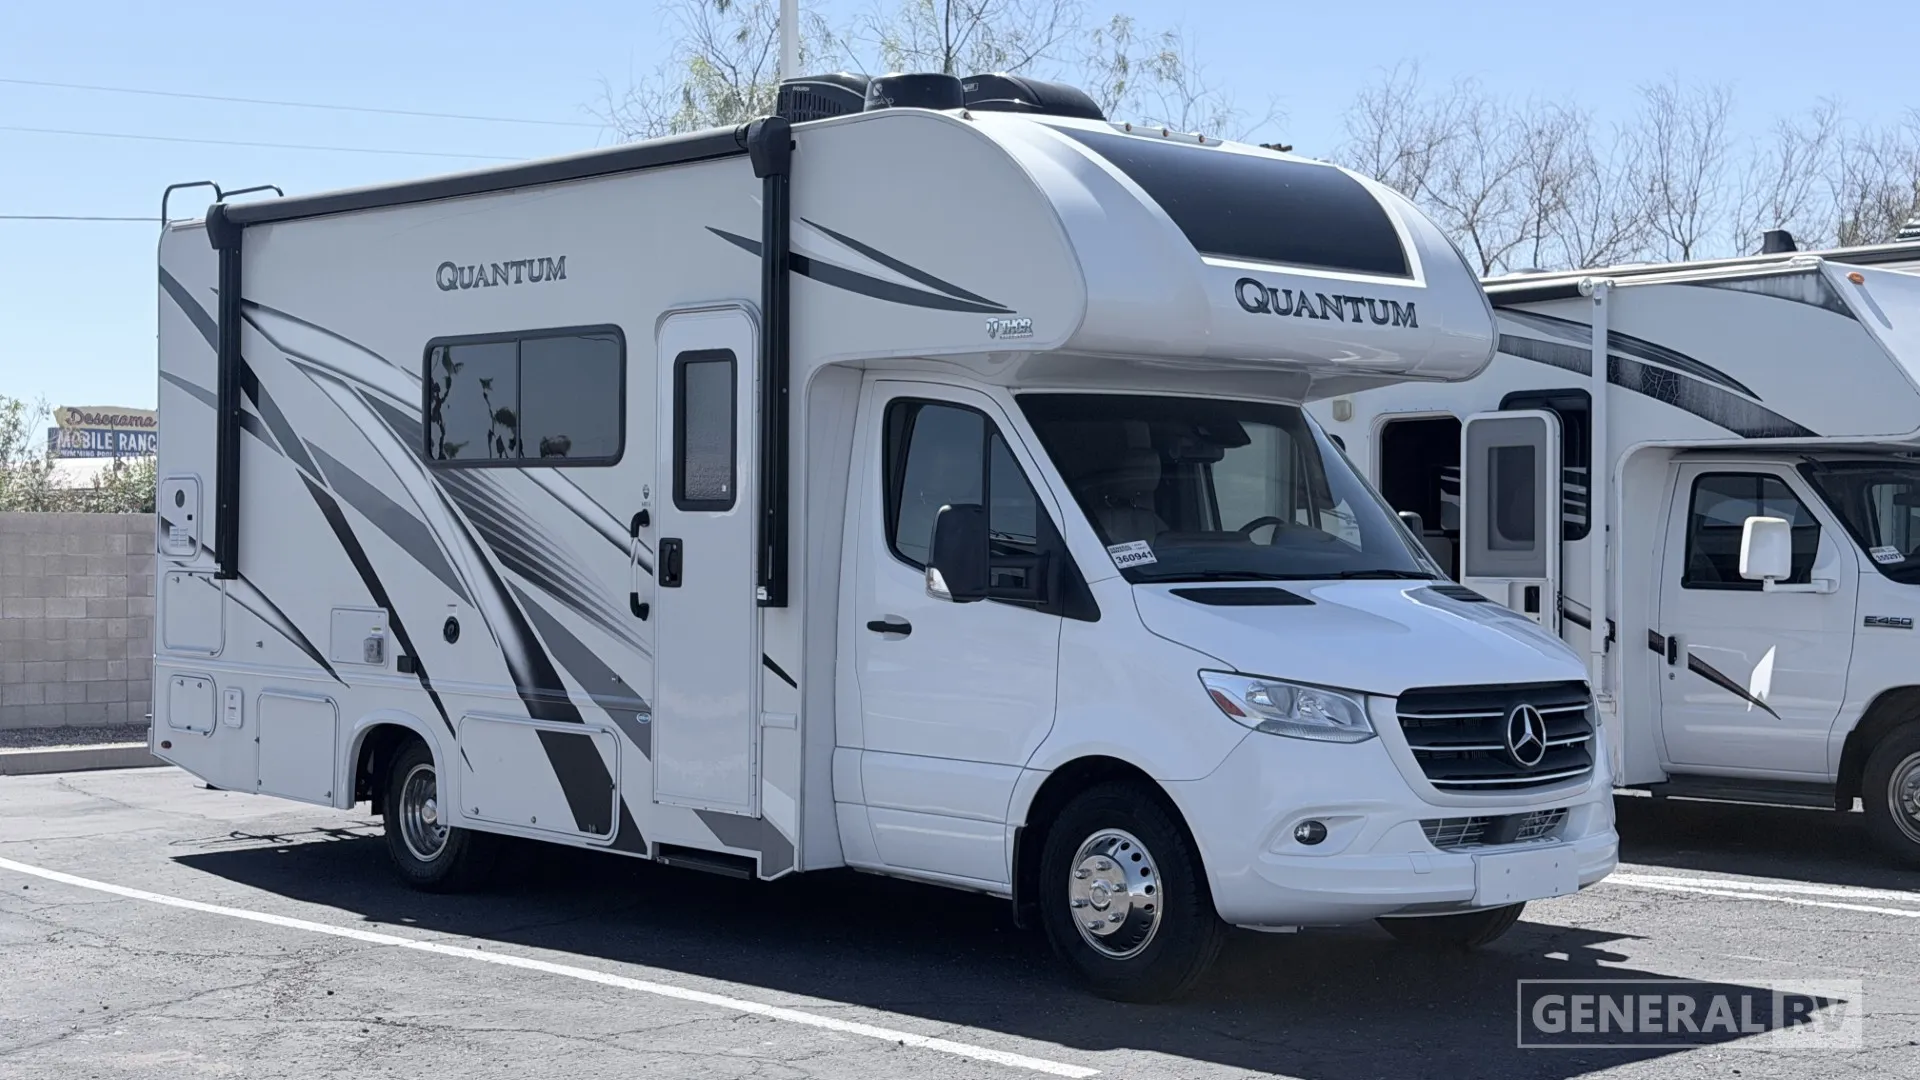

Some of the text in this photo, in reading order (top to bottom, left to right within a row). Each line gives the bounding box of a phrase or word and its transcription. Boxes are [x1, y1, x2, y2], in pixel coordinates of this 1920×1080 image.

[436, 255, 567, 291] QUANTUM
[1234, 277, 1419, 328] QUANTUM
[999, 318, 1033, 334] THOR
[58, 431, 157, 452] MOBILE RANC
[1115, 551, 1154, 564] 360941
